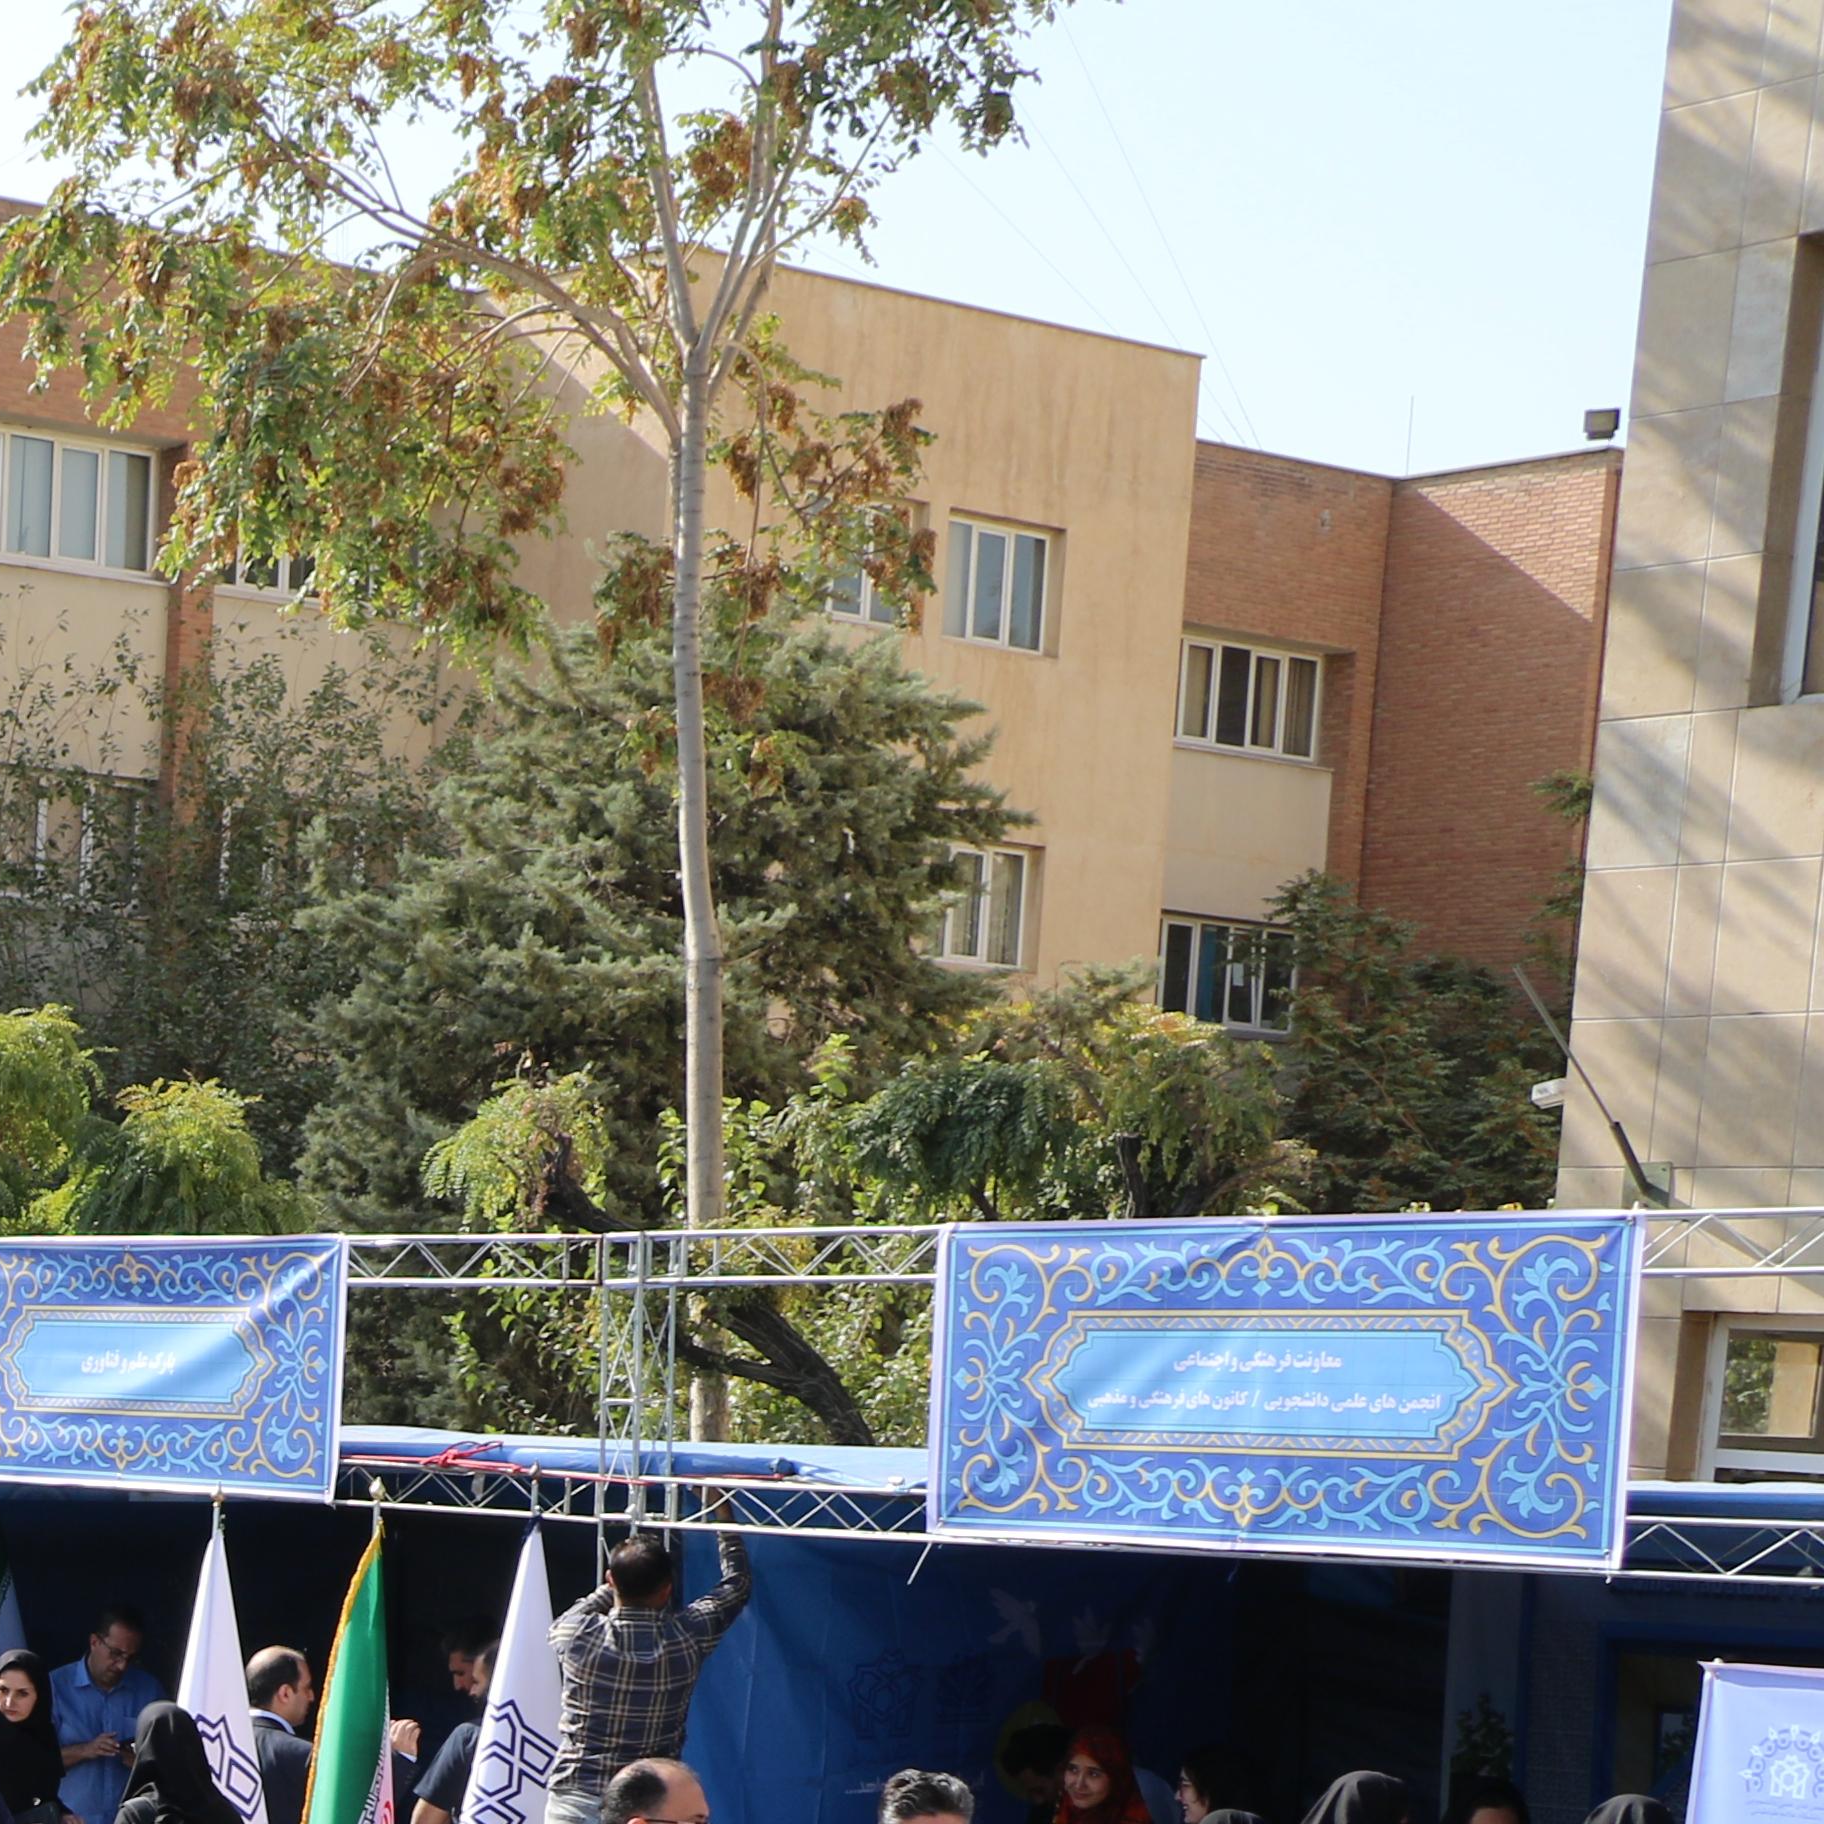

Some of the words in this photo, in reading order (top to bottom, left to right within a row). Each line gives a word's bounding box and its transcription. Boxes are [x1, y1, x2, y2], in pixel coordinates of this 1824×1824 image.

[80, 1348, 120, 1374] فناوری
[127, 1351, 149, 1374] علم
[149, 1351, 177, 1375] پارک
[1172, 1350, 1230, 1373] اجتماعی
[1239, 1348, 1293, 1374] فرهنگی
[1292, 1350, 1343, 1372] معاونت
[1087, 1387, 1129, 1409] مذهبی
[1138, 1388, 1186, 1410] فرهنگی
[1186, 1388, 1213, 1408] های
[1214, 1390, 1249, 1410] کانون
[1263, 1391, 1329, 1414] دانشجویی
[1331, 1393, 1367, 1414] علمی
[1369, 1393, 1397, 1414] های
[1398, 1393, 1442, 1414] انجمن
